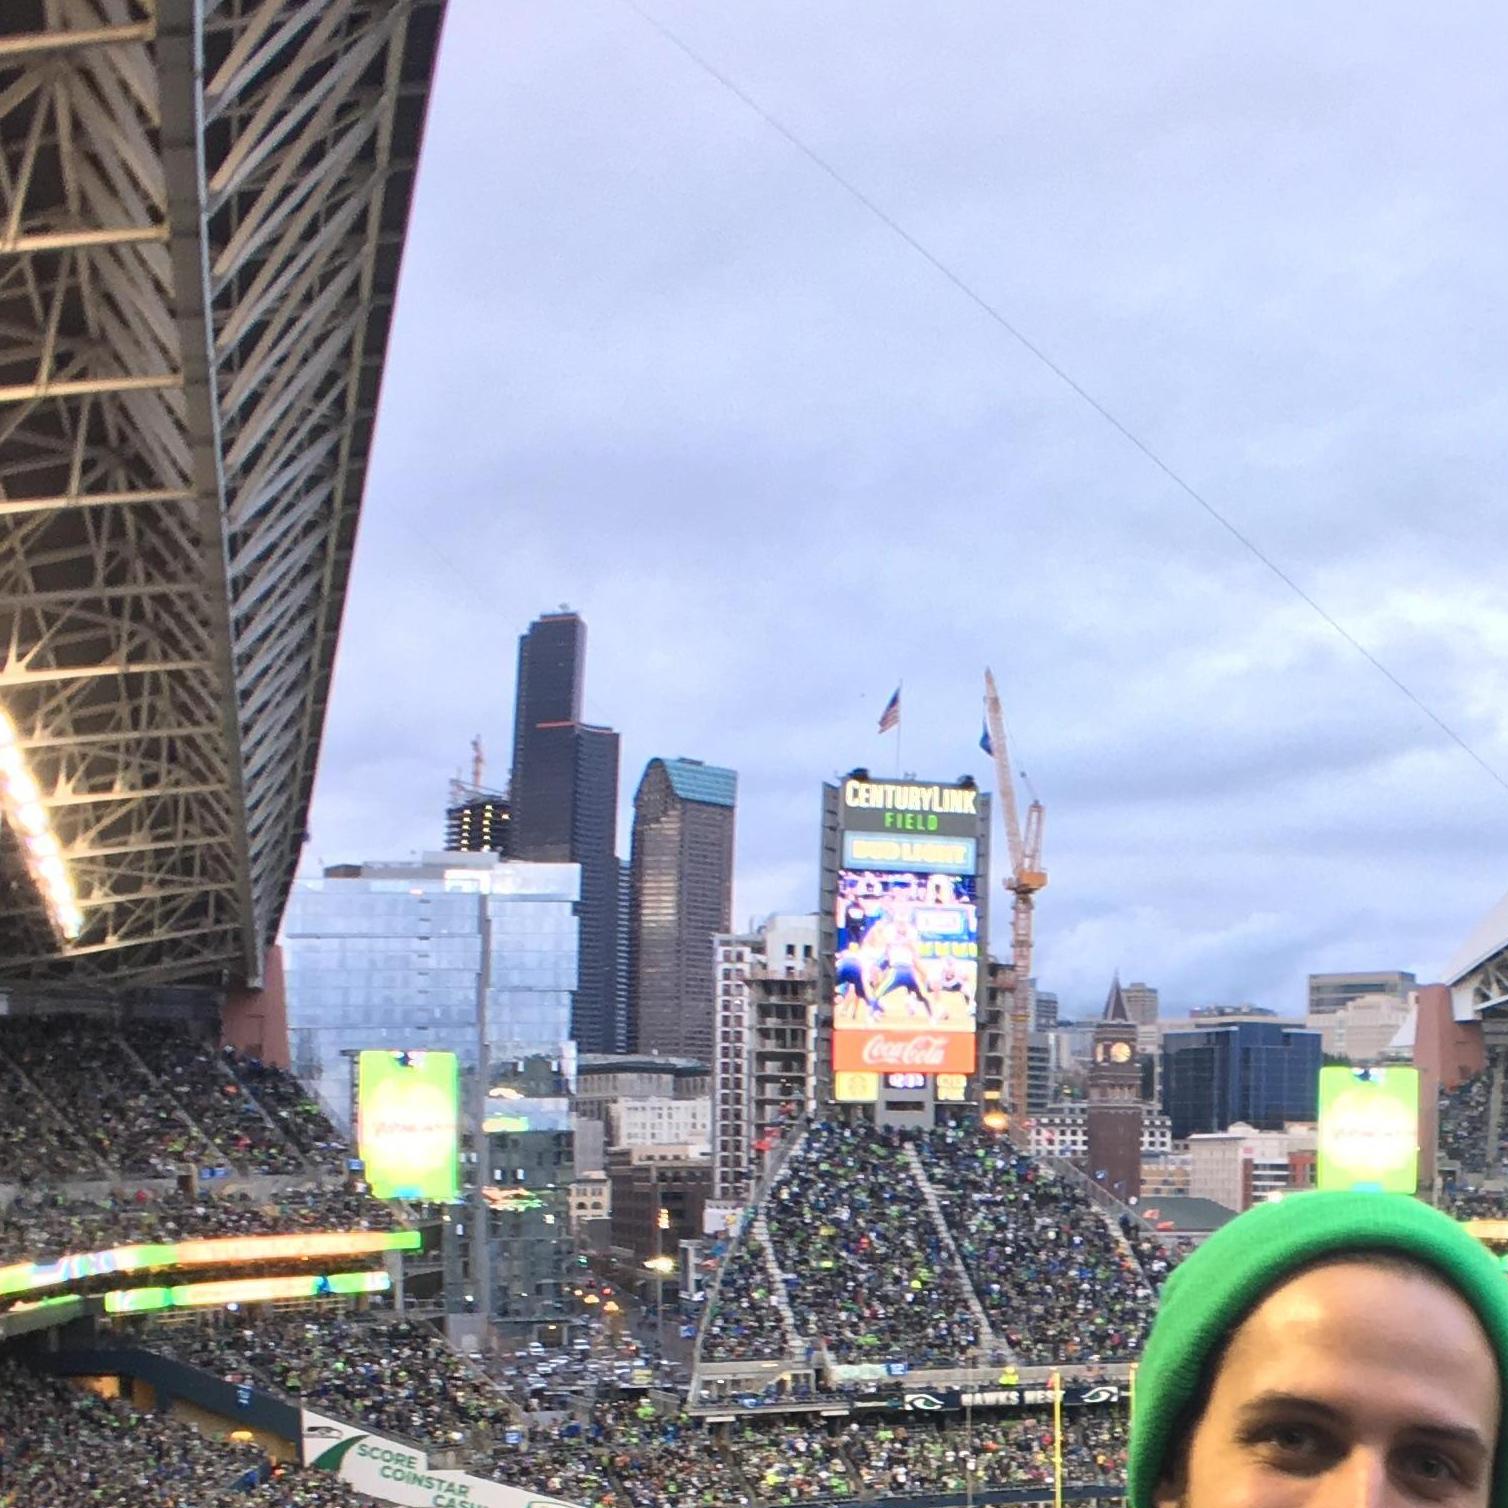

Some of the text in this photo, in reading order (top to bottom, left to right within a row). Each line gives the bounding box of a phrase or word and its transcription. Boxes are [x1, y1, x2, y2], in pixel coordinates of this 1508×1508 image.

[884, 812, 938, 831] FIELD
[961, 1390, 1020, 1407] HAWKS
[356, 1443, 418, 1469] SCORE
[380, 1465, 470, 1498] COINSTAR
